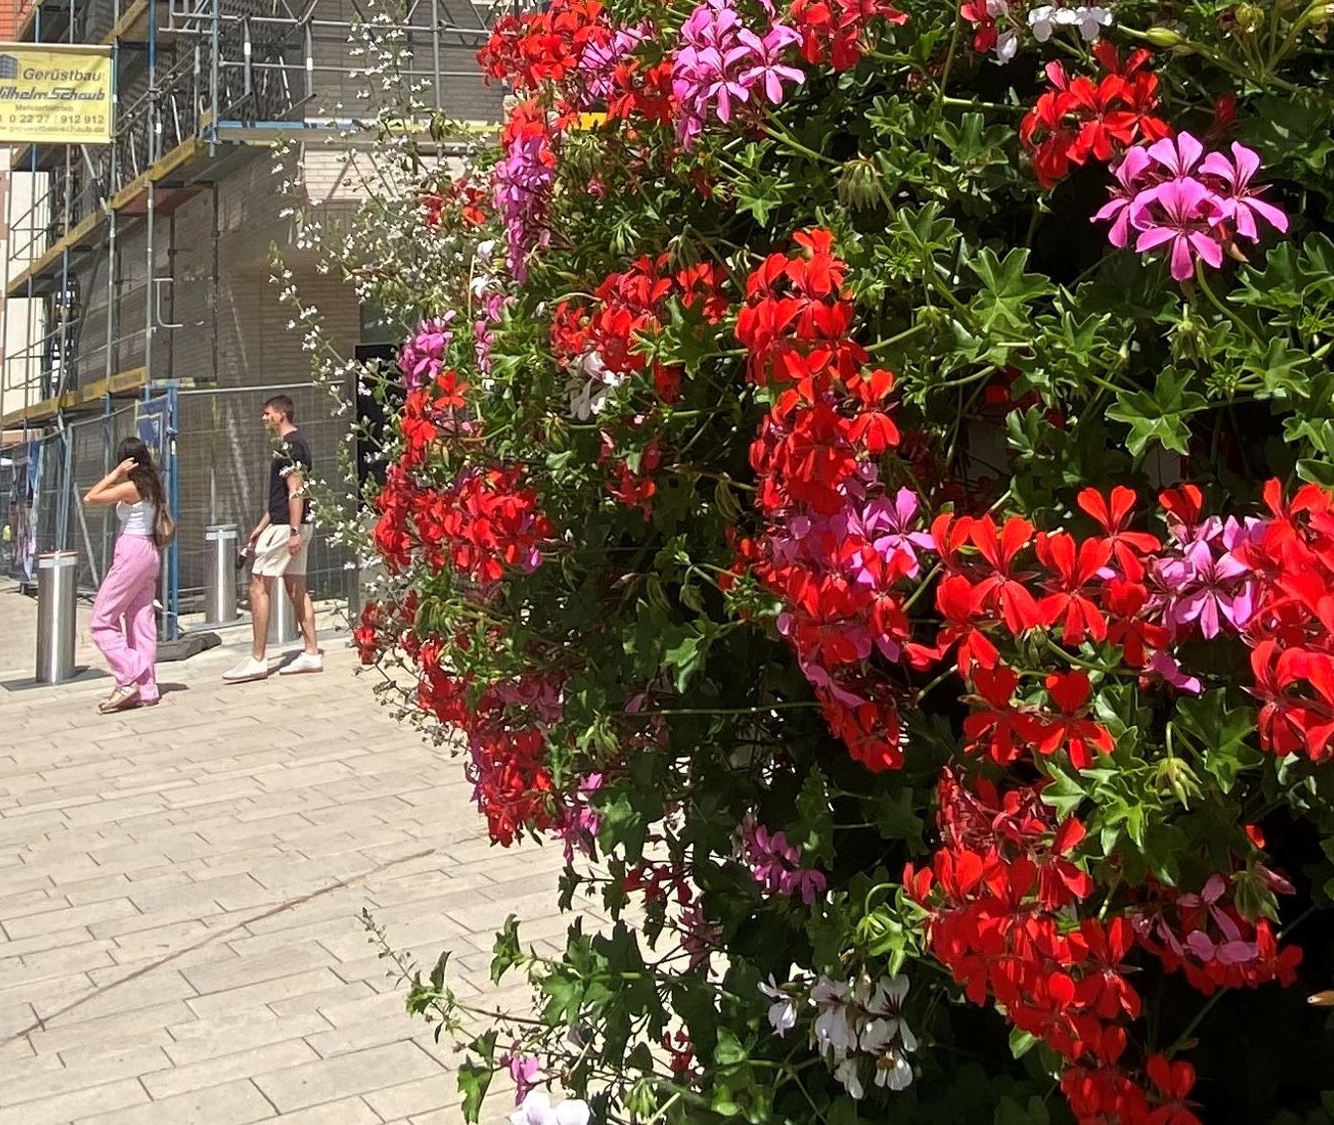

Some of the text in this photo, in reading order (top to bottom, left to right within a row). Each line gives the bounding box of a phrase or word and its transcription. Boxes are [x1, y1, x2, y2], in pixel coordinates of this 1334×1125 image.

[23, 67, 102, 82] Gerüstbau
[60, 114, 82, 125] 912
[83, 115, 105, 125] 912
